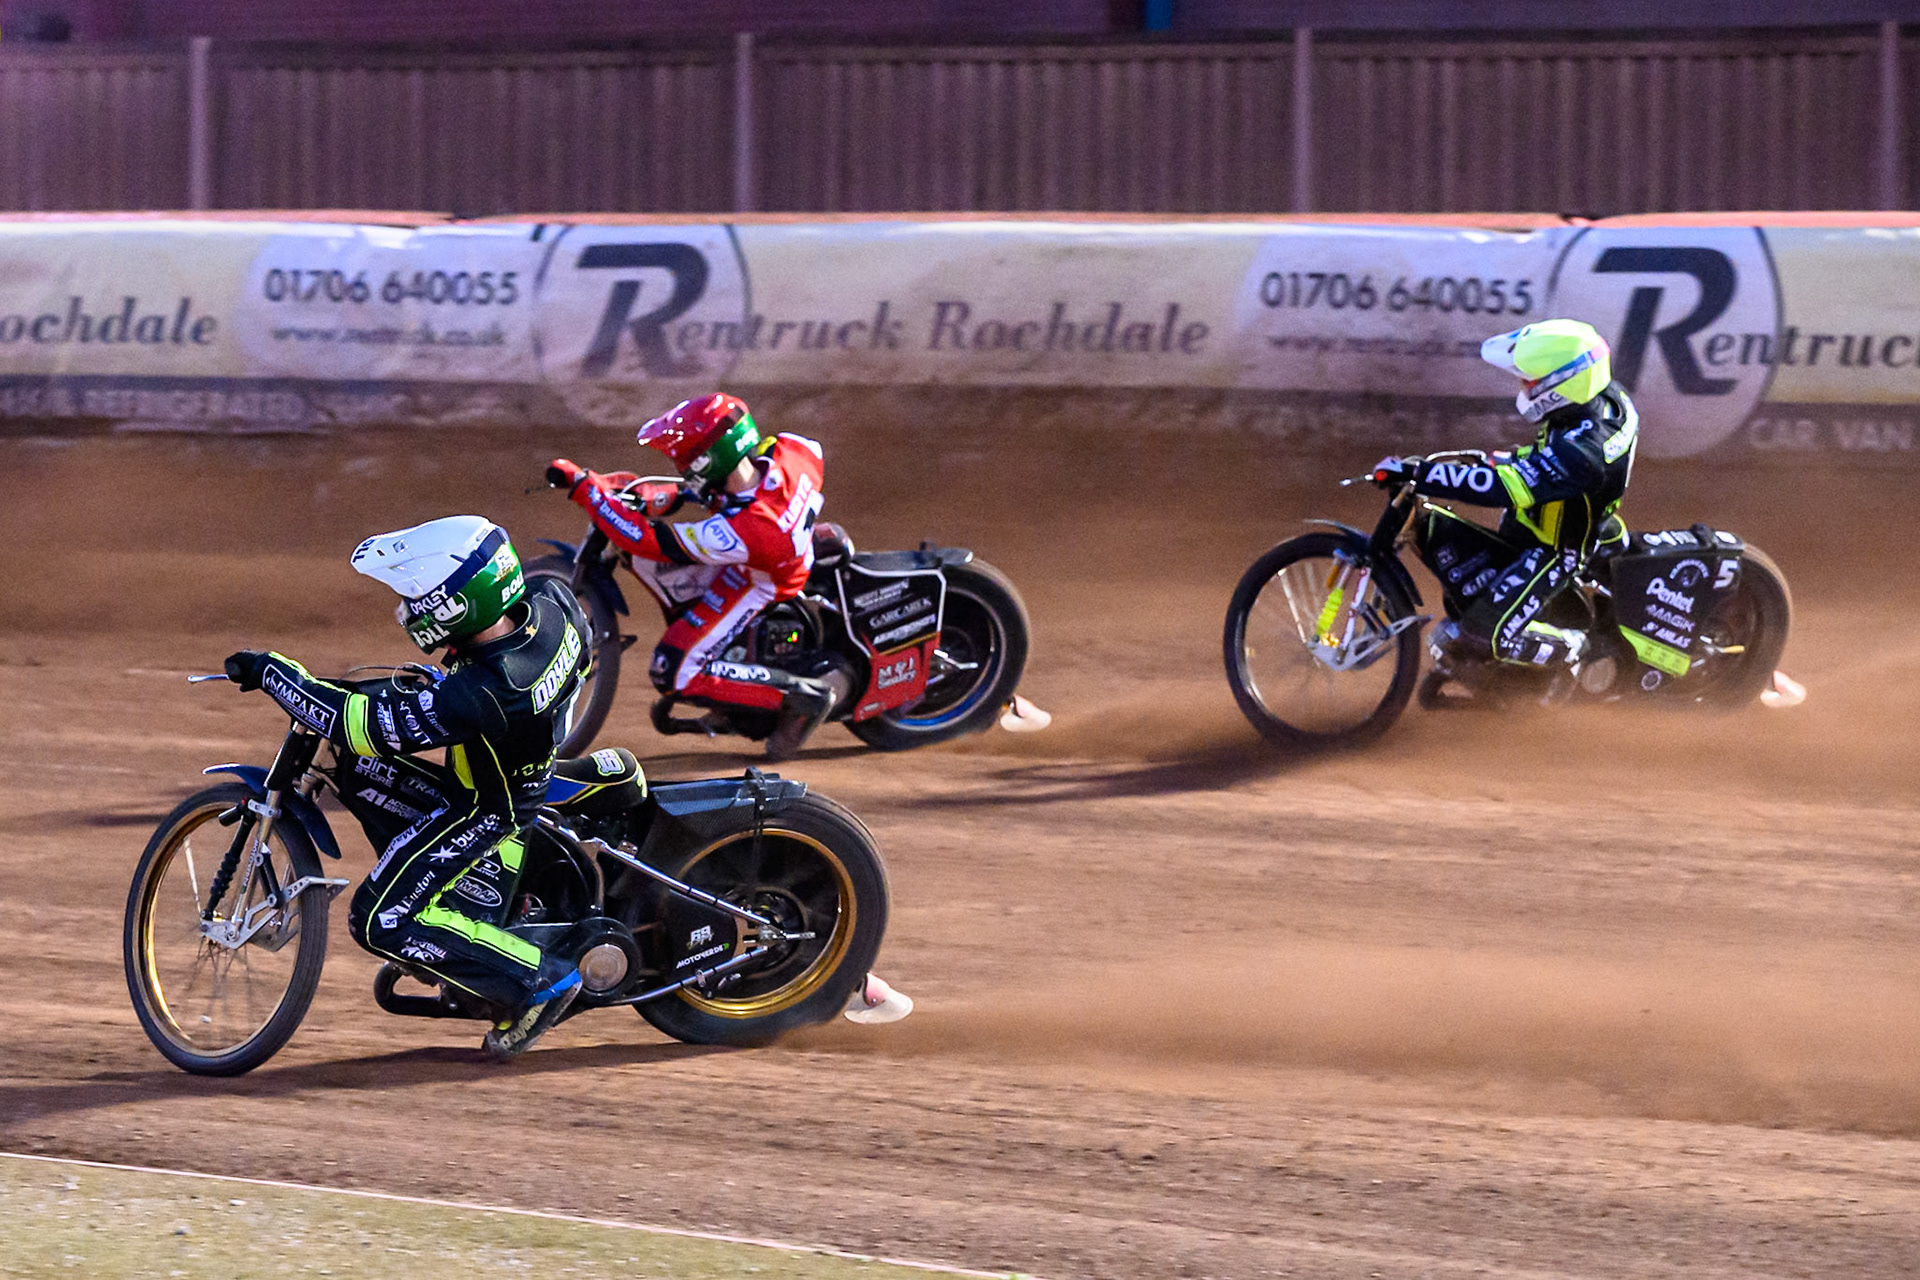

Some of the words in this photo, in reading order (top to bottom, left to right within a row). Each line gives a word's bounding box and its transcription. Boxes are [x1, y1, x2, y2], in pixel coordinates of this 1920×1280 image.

[263, 268, 371, 302] 01706
[381, 270, 519, 306] 640055
[1259, 271, 1378, 309] 01706
[1386, 276, 1534, 316] 640055
[926, 299, 1211, 355] Rochdale
[1425, 463, 1495, 493] AVO
[1712, 558, 1742, 590] 5
[409, 584, 450, 616] OAKLEY
[1502, 598, 1542, 641] ANLAS
[533, 628, 581, 713] DOYLE
[275, 680, 331, 724] IMPAKT
[354, 765, 394, 790] STORE
[357, 755, 400, 782] dirt
[356, 786, 389, 807] A1
[403, 870, 437, 912] Euston
[675, 943, 724, 969] MOTOVERDE
